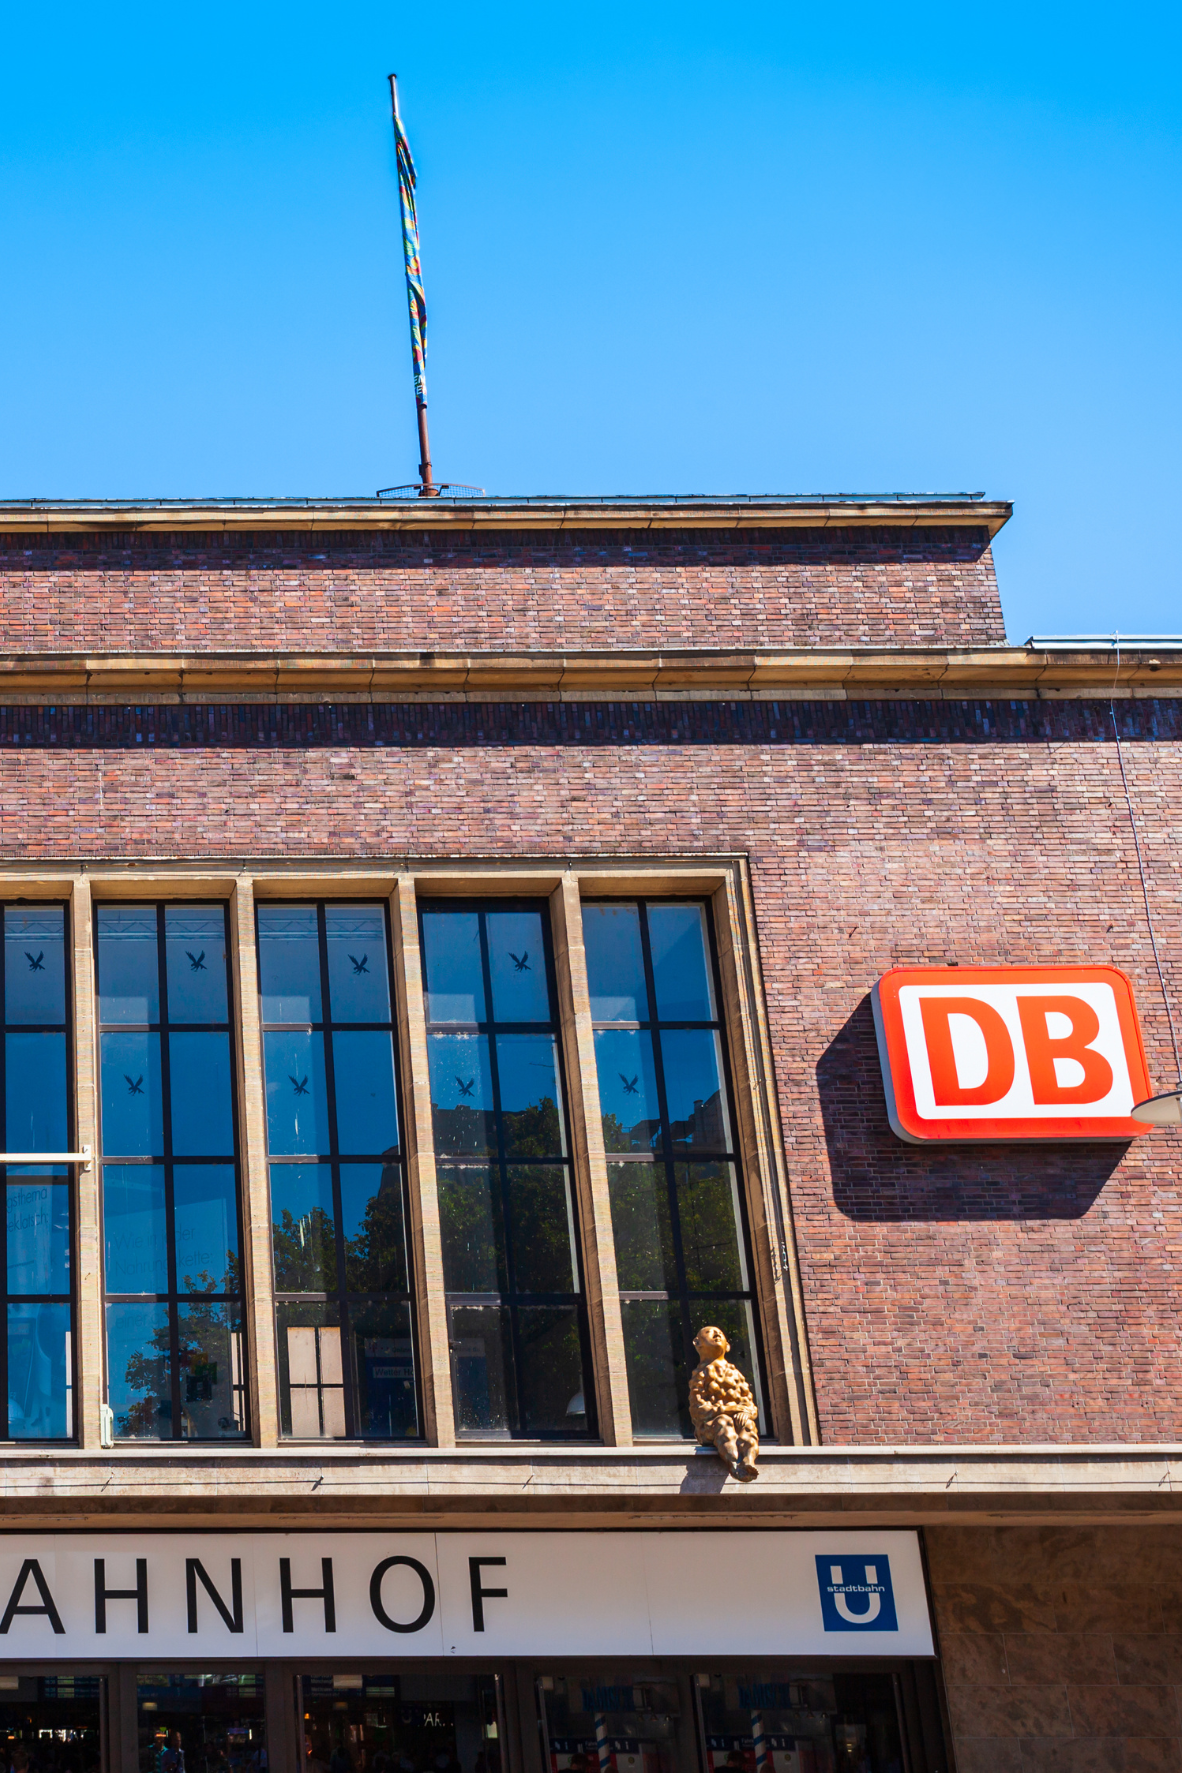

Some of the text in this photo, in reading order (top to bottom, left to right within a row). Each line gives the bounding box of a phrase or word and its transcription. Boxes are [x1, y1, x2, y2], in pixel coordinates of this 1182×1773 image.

[919, 995, 1114, 1107] DB
[161, 1223, 196, 1251] jder
[115, 1249, 213, 1277] Nahrungkette:
[826, 1584, 886, 1592] stadtbahn
[829, 1565, 882, 1624] U
